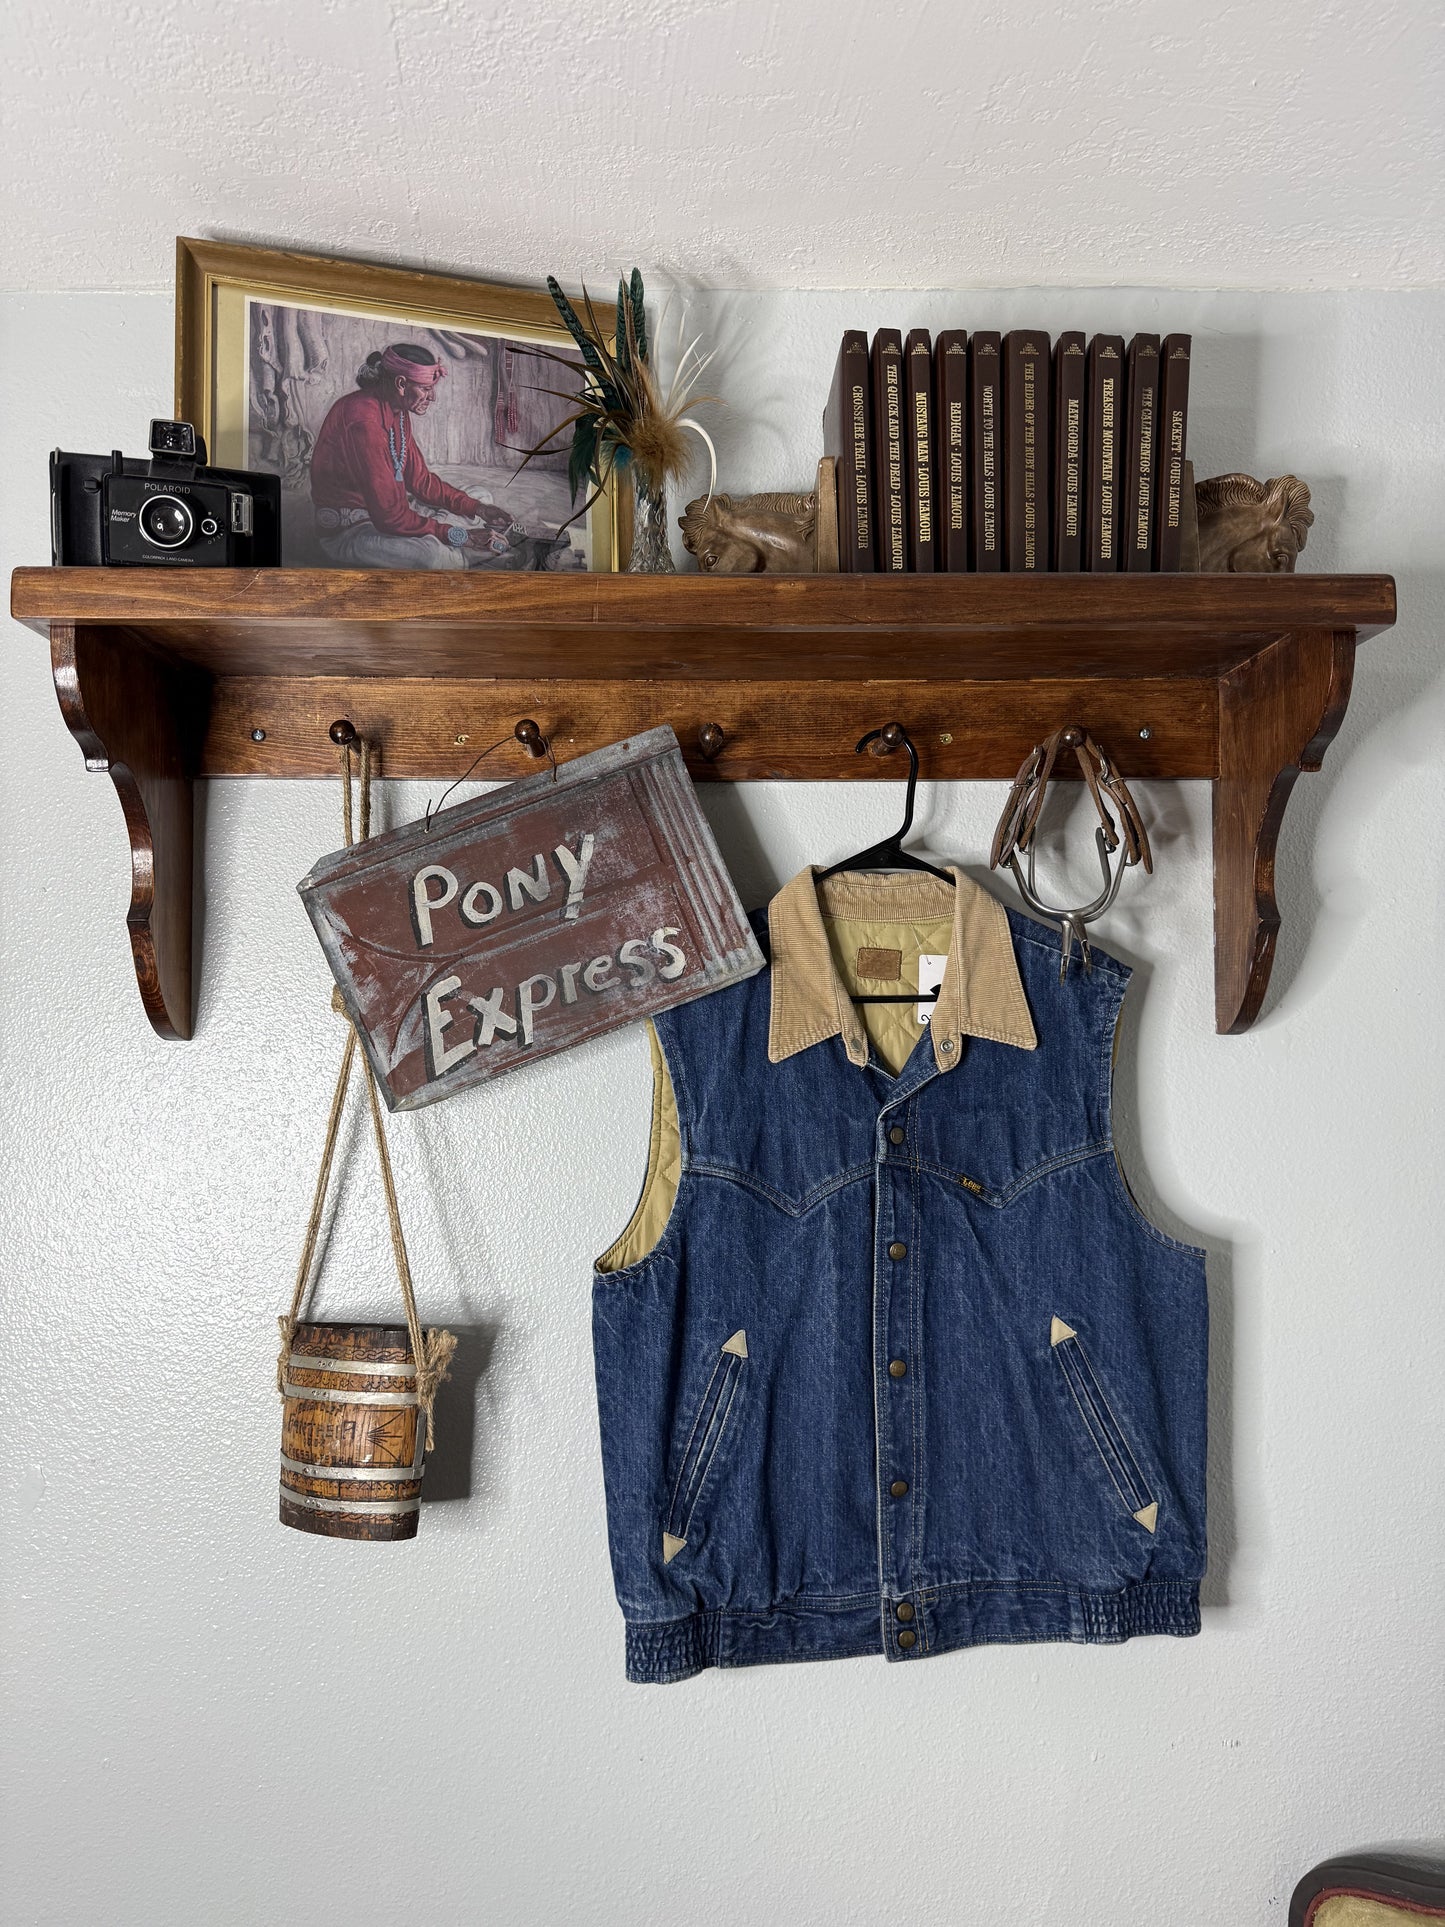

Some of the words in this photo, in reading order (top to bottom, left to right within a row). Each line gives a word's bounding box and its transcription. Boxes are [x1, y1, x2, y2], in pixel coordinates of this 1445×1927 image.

[886, 364, 897, 385] THE
[1024, 362, 1034, 381] THE
[887, 385, 898, 418] QUICK
[982, 385, 993, 417] NORTH
[1024, 382, 1034, 411] RIDER
[1102, 377, 1113, 428] TREASURE
[1141, 386, 1152, 408] THE
[852, 385, 864, 440] CROSSFIRE
[915, 391, 927, 438] MUSTANG
[950, 401, 961, 447] RADIGAN
[983, 417, 993, 430] TO
[1024, 412, 1034, 426] OF
[888, 418, 899, 440] AND
[983, 430, 993, 450] THE
[1024, 425, 1034, 445] THE
[1067, 398, 1078, 459] MATAGORDA
[1139, 408, 1151, 473] CALIFORNIOS
[1171, 410, 1182, 453] SACKETT
[854, 440, 865, 471] TRAIL
[889, 440, 899, 462] THE
[917, 439, 928, 463] MAN
[983, 450, 994, 477] RAILS
[1024, 446, 1034, 471] RUBY
[1102, 429, 1113, 482] MOUNTAIN
[889, 462, 900, 490] DEAD
[917, 467, 929, 498] LOUIS
[950, 452, 961, 483] LOUIS
[1067, 462, 1078, 493] LOUIS
[144, 482, 191, 495] POLAROID
[855, 474, 867, 505] LOUIS
[984, 481, 994, 509] LOUIS
[1025, 470, 1034, 499] HILLS
[1101, 485, 1112, 515] LOUIS
[1138, 476, 1149, 507] LOUIS
[110, 514, 130, 523] Maker
[111, 509, 137, 518] Memory
[890, 494, 901, 525] LOUIS
[918, 499, 930, 543] L'AMOUR
[950, 485, 962, 530] L'AMOUR
[1025, 501, 1035, 529] LOUIS
[1066, 494, 1077, 537] L'AMOUR
[1168, 486, 1179, 528] L'AMOUR
[856, 506, 868, 549] L'AMOUR
[984, 510, 994, 551] L'AMOUR
[1100, 516, 1111, 559] L'AMOUR
[1136, 507, 1148, 550] L'AMOUR
[891, 526, 902, 570] L'AMOUR
[1025, 530, 1035, 569] L'AMOUR
[424, 927, 687, 1076] Express
